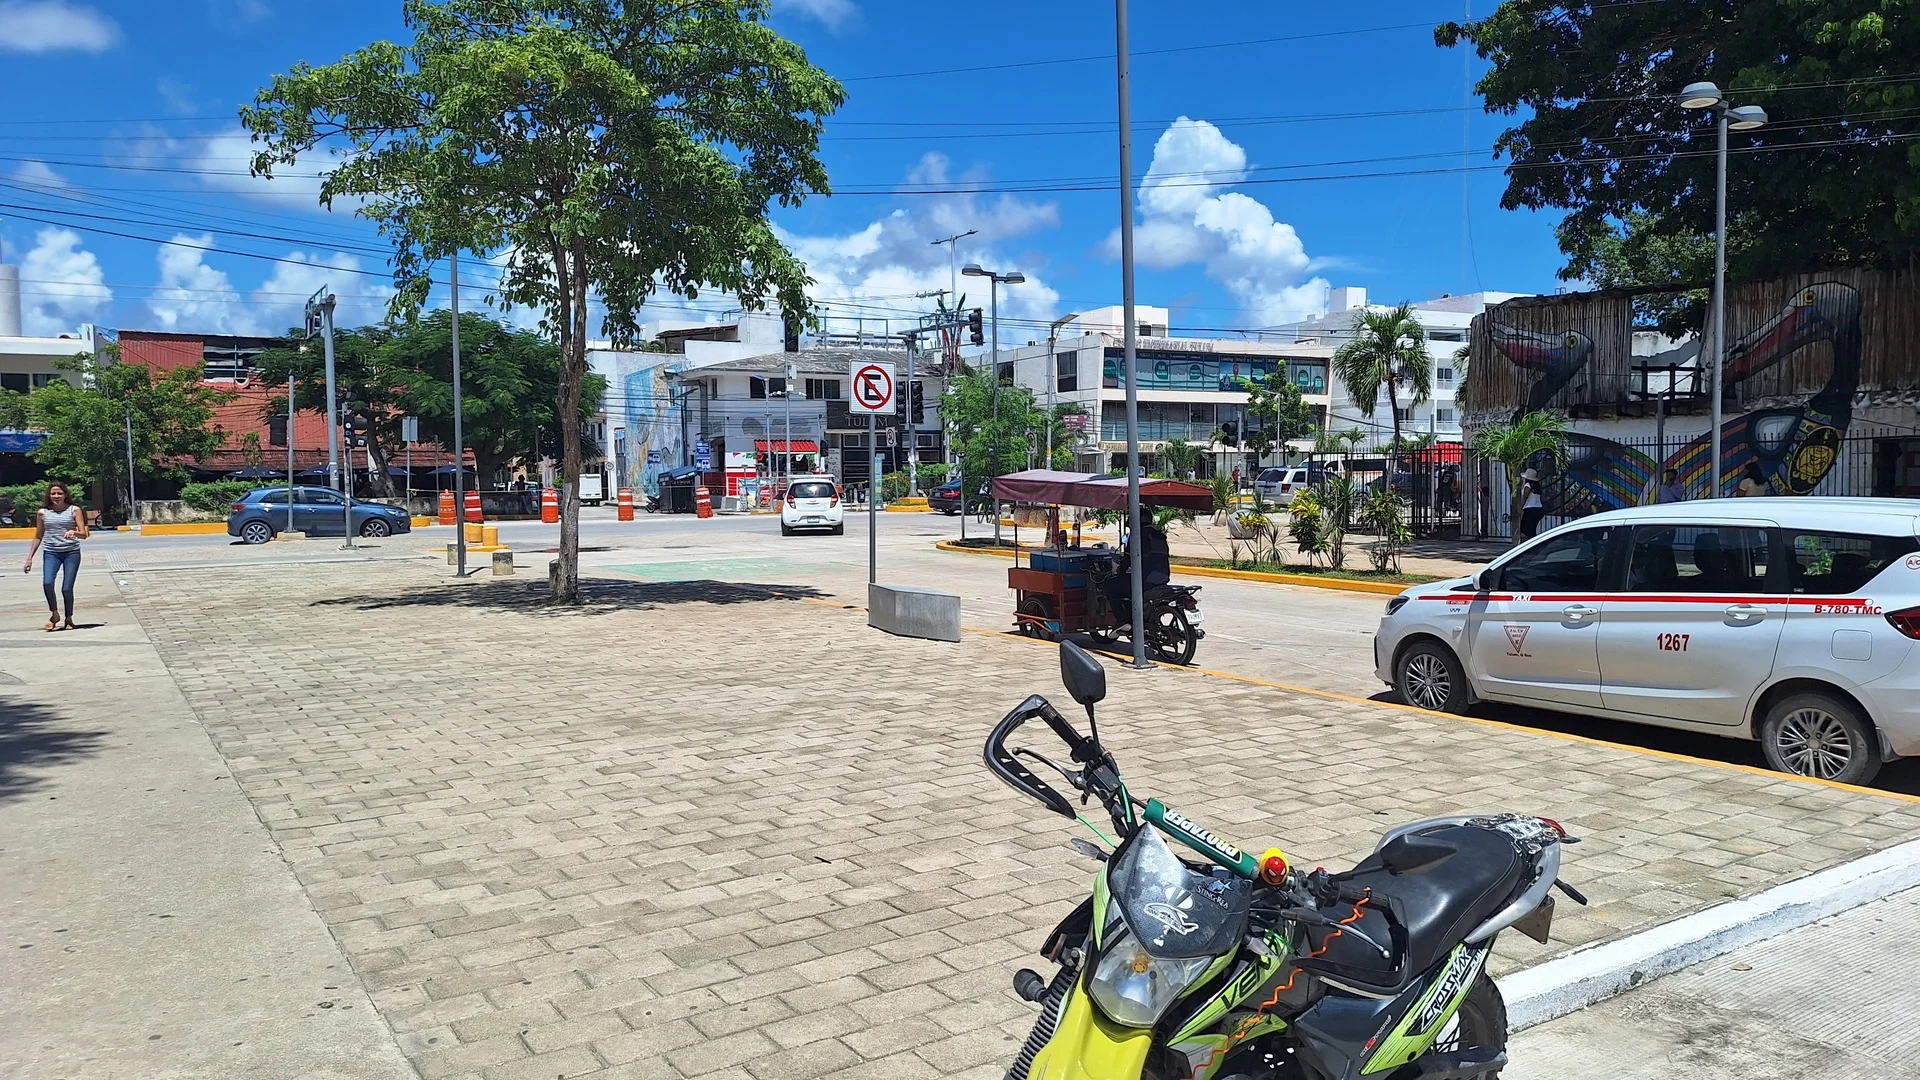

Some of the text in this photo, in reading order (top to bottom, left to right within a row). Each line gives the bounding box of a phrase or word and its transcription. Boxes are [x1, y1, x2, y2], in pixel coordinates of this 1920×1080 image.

[845, 416, 888, 427] TULM
[1814, 605, 1882, 615] B-780-TMC
[1656, 632, 1690, 652] 1267
[1164, 808, 1240, 858] PROTAPER
[1422, 946, 1473, 1027] CROSSMAX
